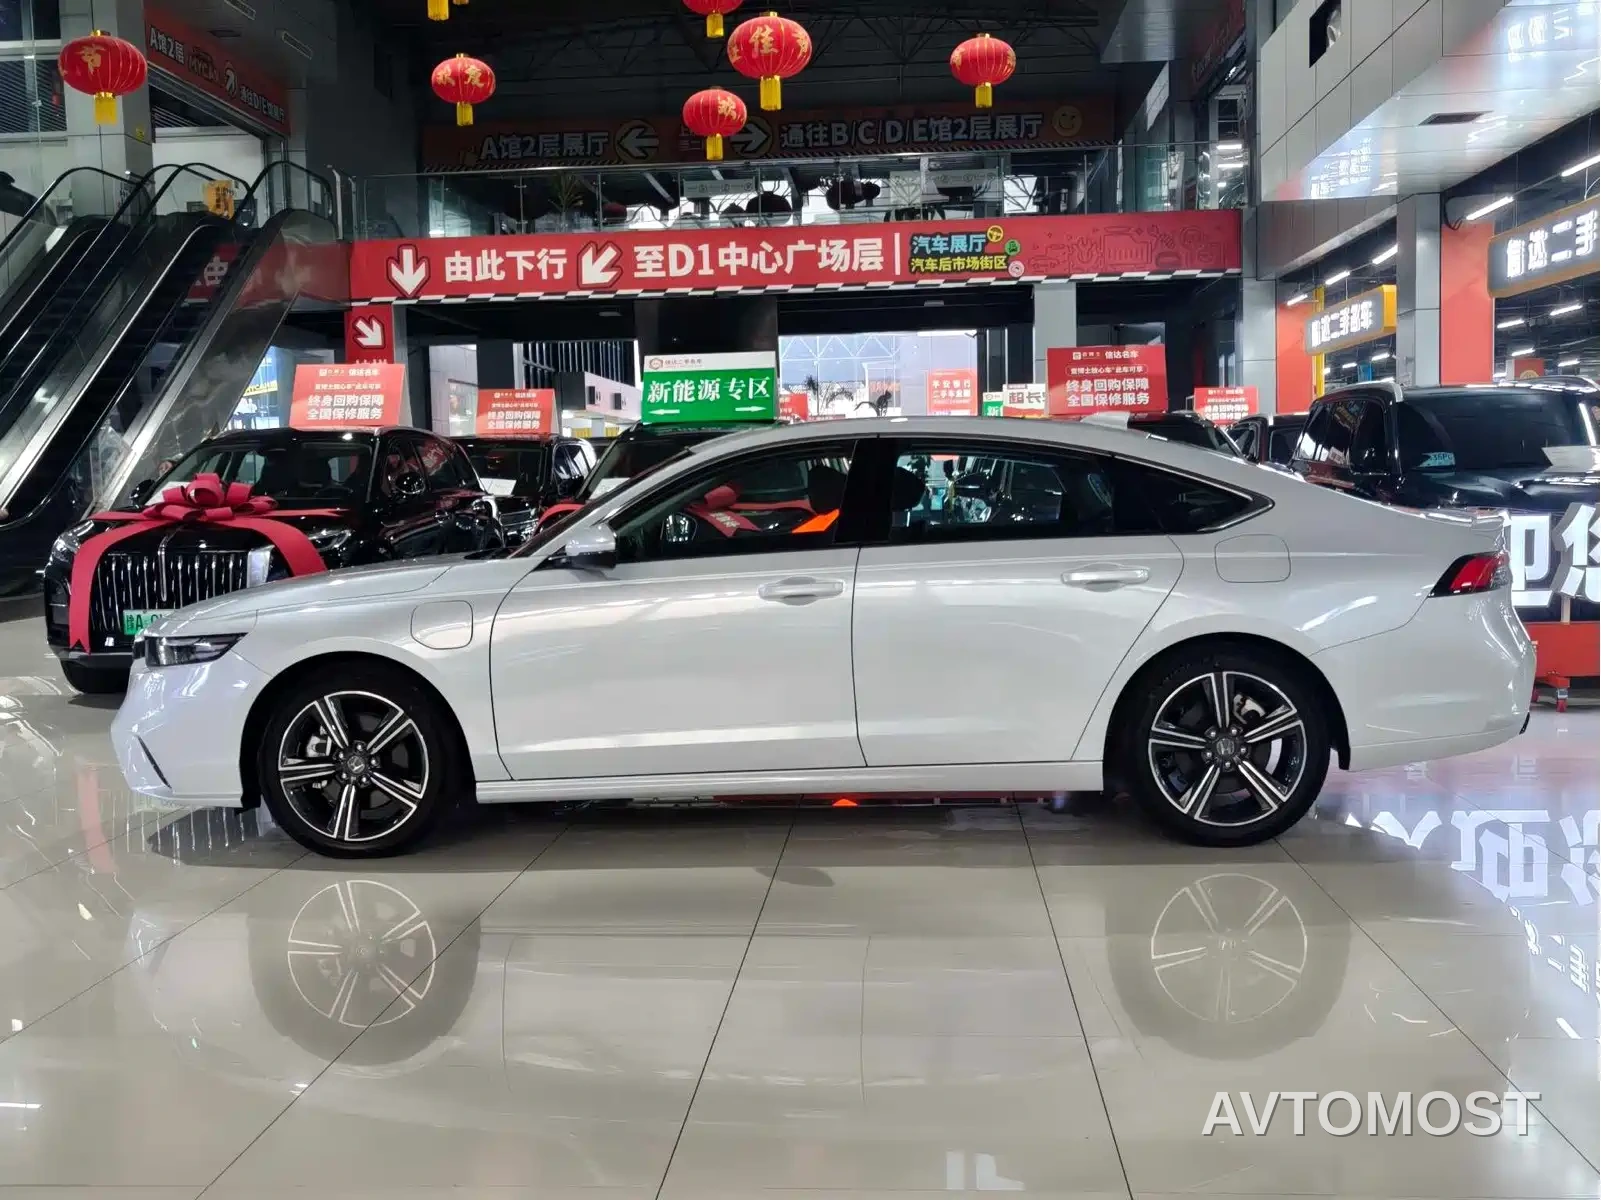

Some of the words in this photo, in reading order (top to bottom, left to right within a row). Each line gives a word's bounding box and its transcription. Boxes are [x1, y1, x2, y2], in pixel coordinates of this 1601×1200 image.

[779, 115, 1043, 149] 通往B/C/D/E馆2层展厅
[481, 130, 610, 159] A馆2层展厅
[911, 232, 987, 255] 汽车展厅
[444, 247, 567, 283] 由此下行
[633, 237, 885, 279] 至D1中心广场层
[911, 254, 1008, 273] 汽车后市场街区
[646, 376, 771, 404] 新能源专区
[1065, 377, 1150, 392] 终身回购保障
[307, 394, 385, 407] 终身回购保障
[1008, 390, 1047, 405] 超长
[1066, 392, 1150, 407] 全国保修服务
[307, 407, 384, 420] 全国保修服务
